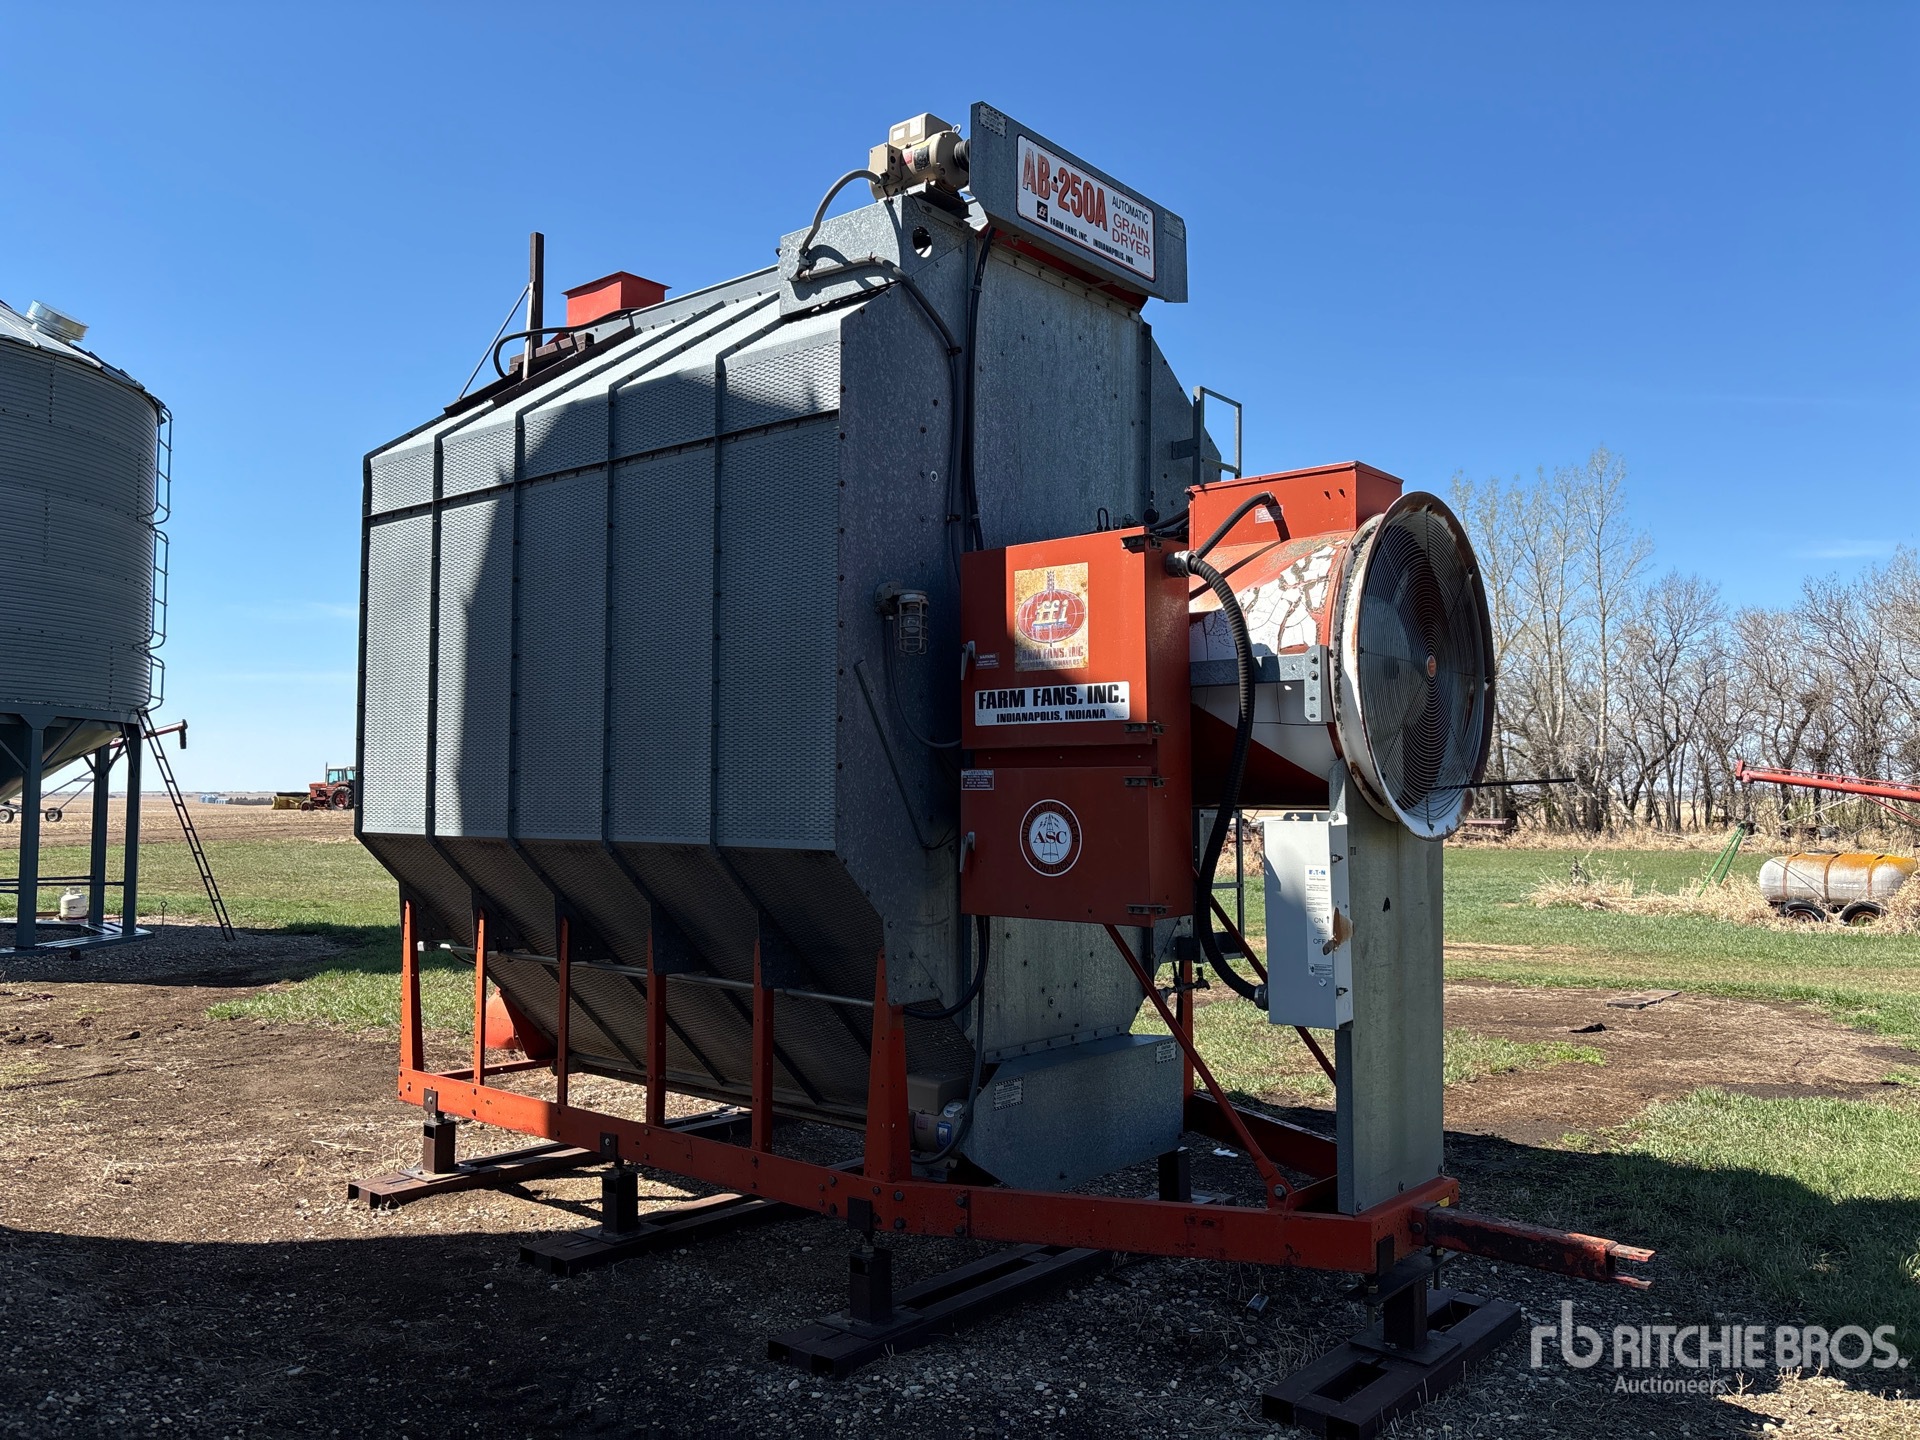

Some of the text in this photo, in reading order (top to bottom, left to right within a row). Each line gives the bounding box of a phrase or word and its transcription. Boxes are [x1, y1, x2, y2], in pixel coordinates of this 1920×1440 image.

[1022, 147, 1108, 232] AB-250A
[1050, 217, 1064, 231] FARM
[1112, 196, 1148, 225] AUTOMATIC
[1113, 213, 1149, 244] GRAIN
[1112, 227, 1150, 260] DRYER
[978, 689, 1025, 709] FARM
[1087, 684, 1125, 704] INC.
[1065, 708, 1106, 720] INDIANA
[1022, 802, 1079, 843] AUTOMATIC SYSTEM
[1033, 831, 1067, 844] ASC
[1031, 858, 1071, 874] CONTROL
